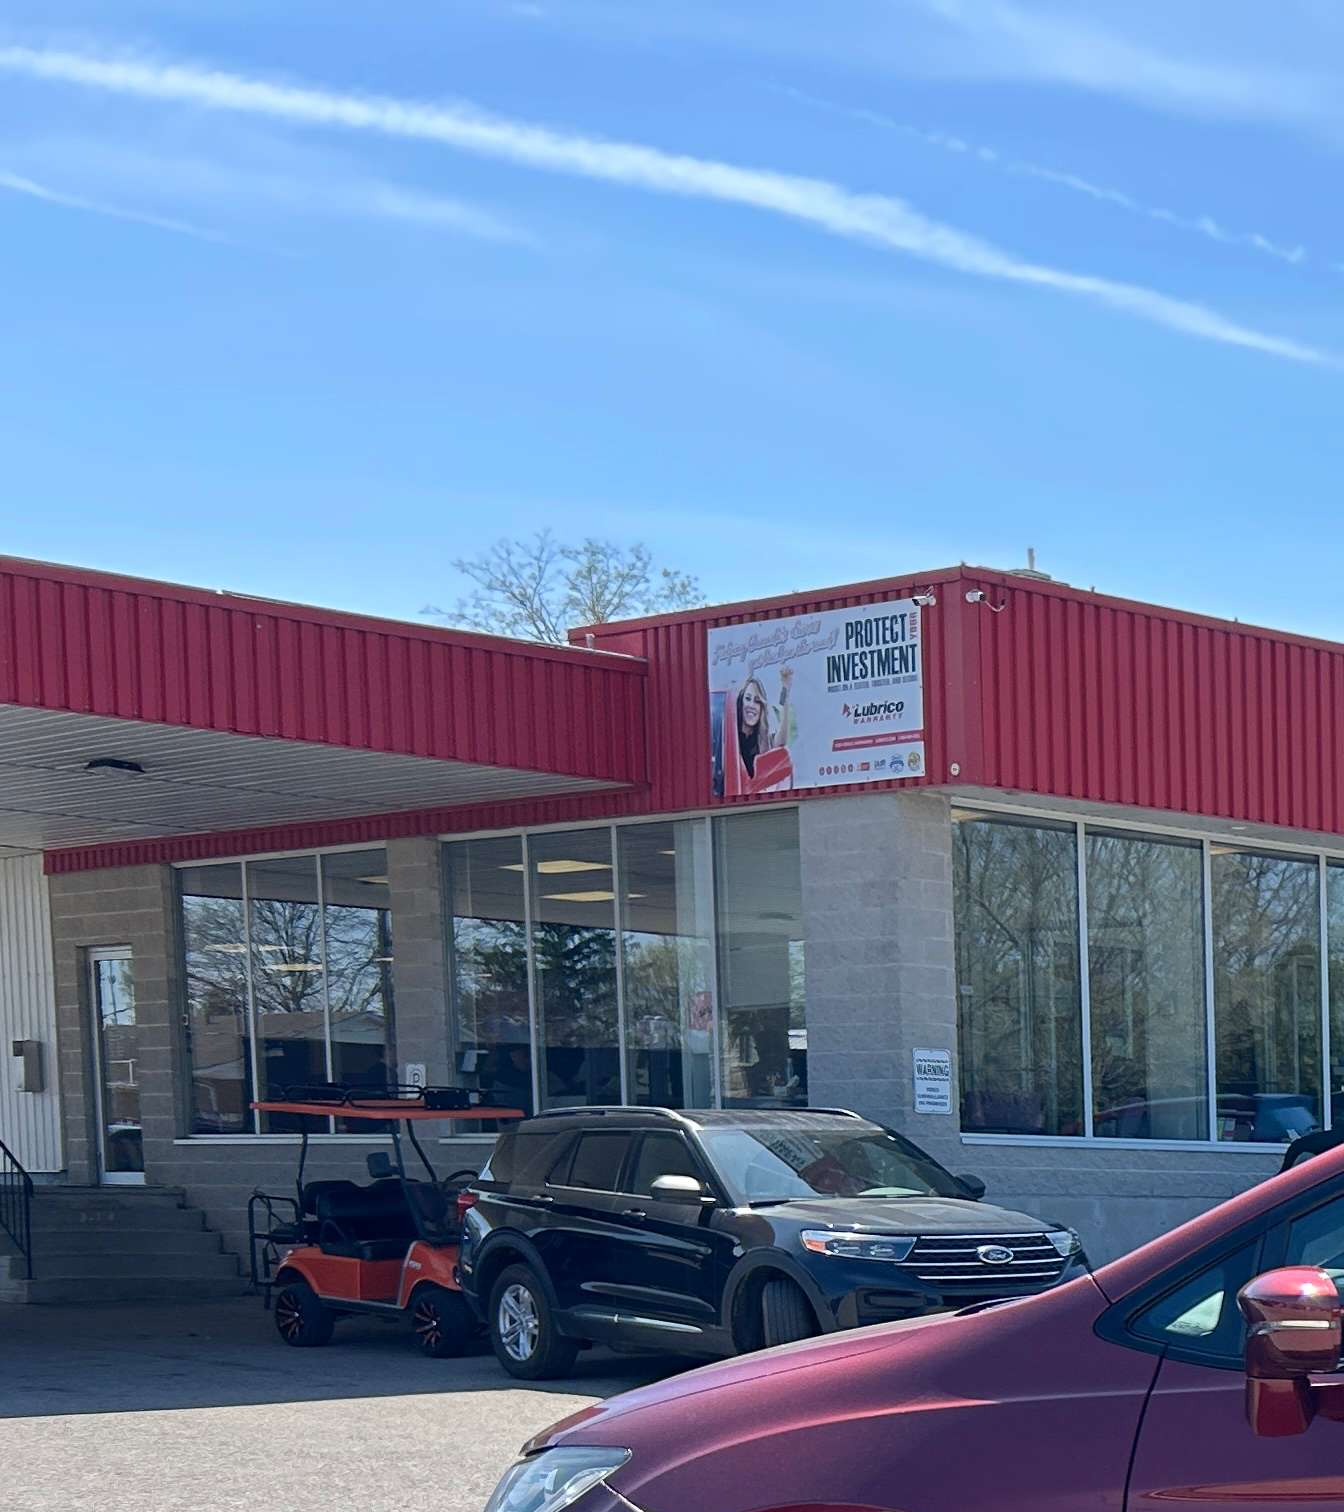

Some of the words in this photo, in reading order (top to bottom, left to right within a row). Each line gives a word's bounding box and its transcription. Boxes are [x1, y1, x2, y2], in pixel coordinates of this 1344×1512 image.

[845, 613, 907, 650] PROTECT
[826, 643, 918, 683] INVESTMENT
[854, 701, 904, 717] Lubrico
[916, 1063, 949, 1076] WARNING
